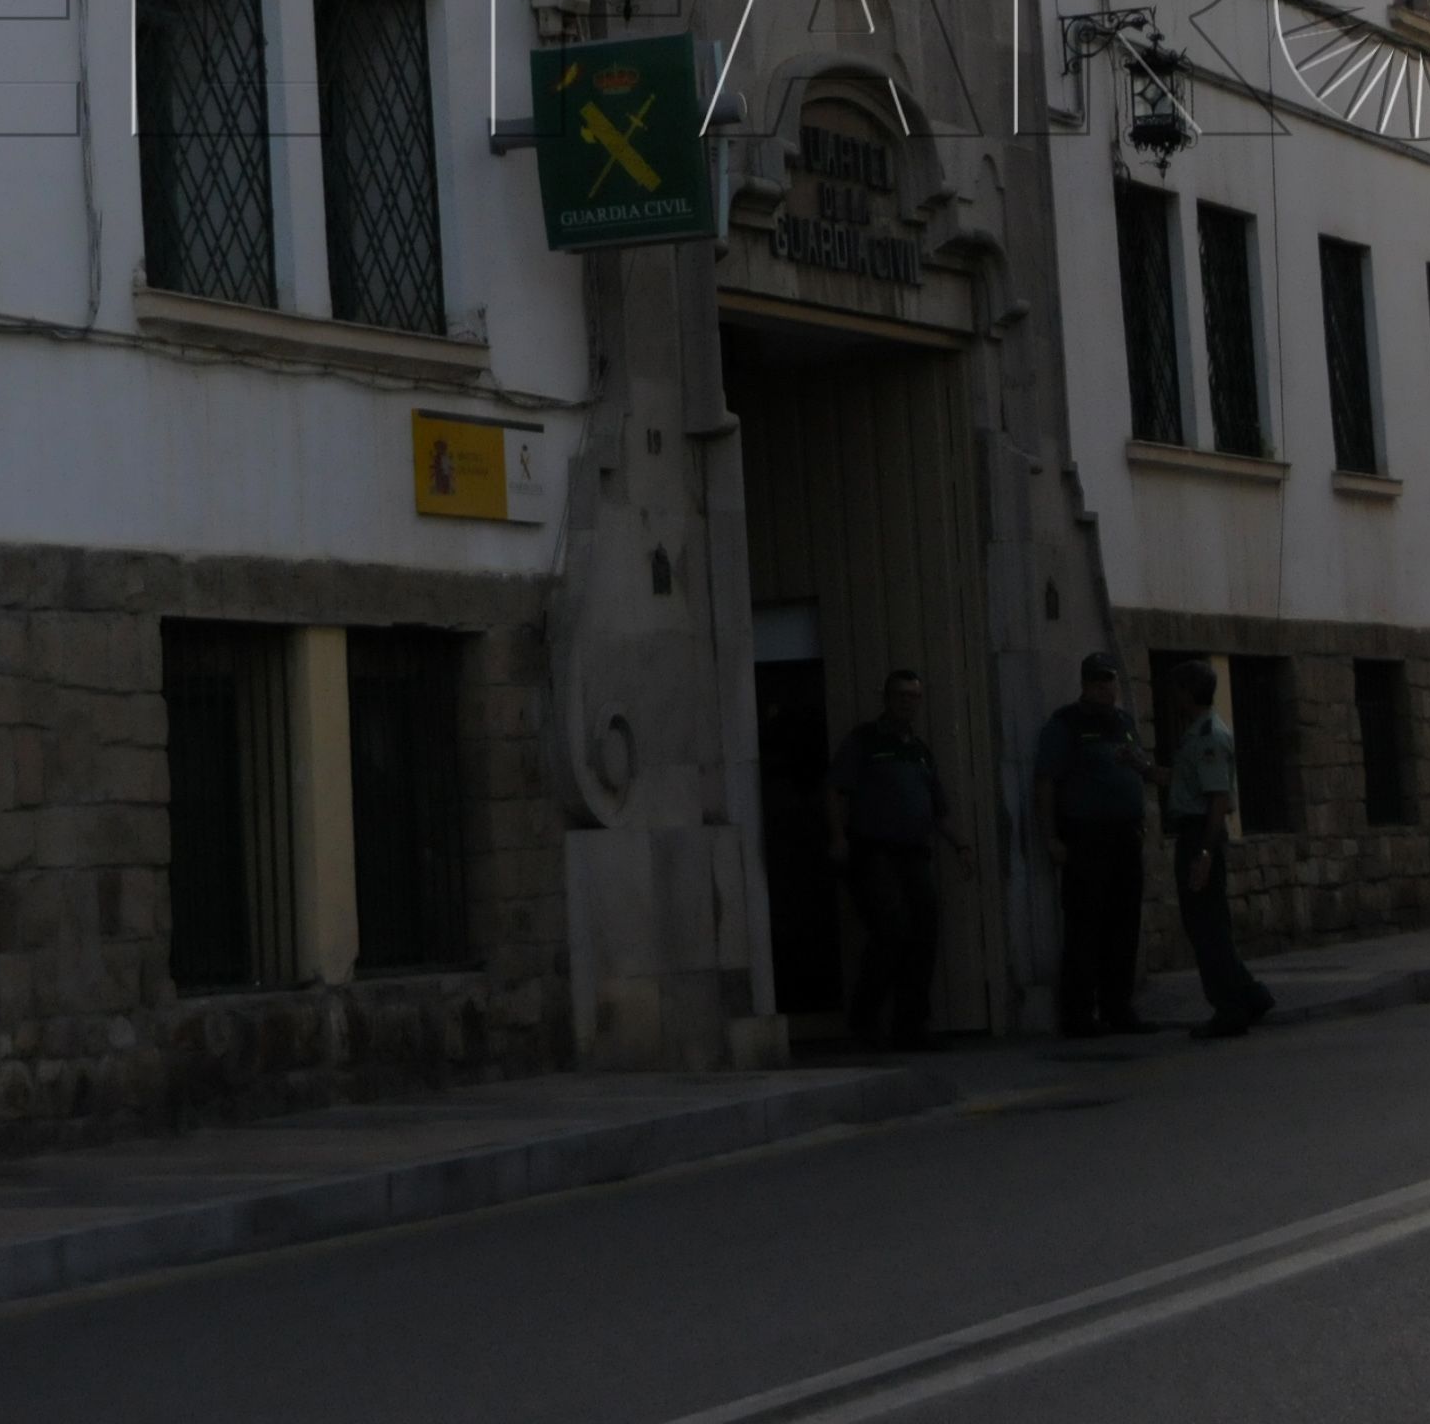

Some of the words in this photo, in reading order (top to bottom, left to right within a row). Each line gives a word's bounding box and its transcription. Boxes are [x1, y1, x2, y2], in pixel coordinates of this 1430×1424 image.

[799, 125, 897, 196] UARTEL
[560, 205, 641, 227] GUARDIA
[643, 196, 693, 217] CIVIL
[771, 211, 871, 274] GUARDIA
[869, 235, 923, 289] CIVIL
